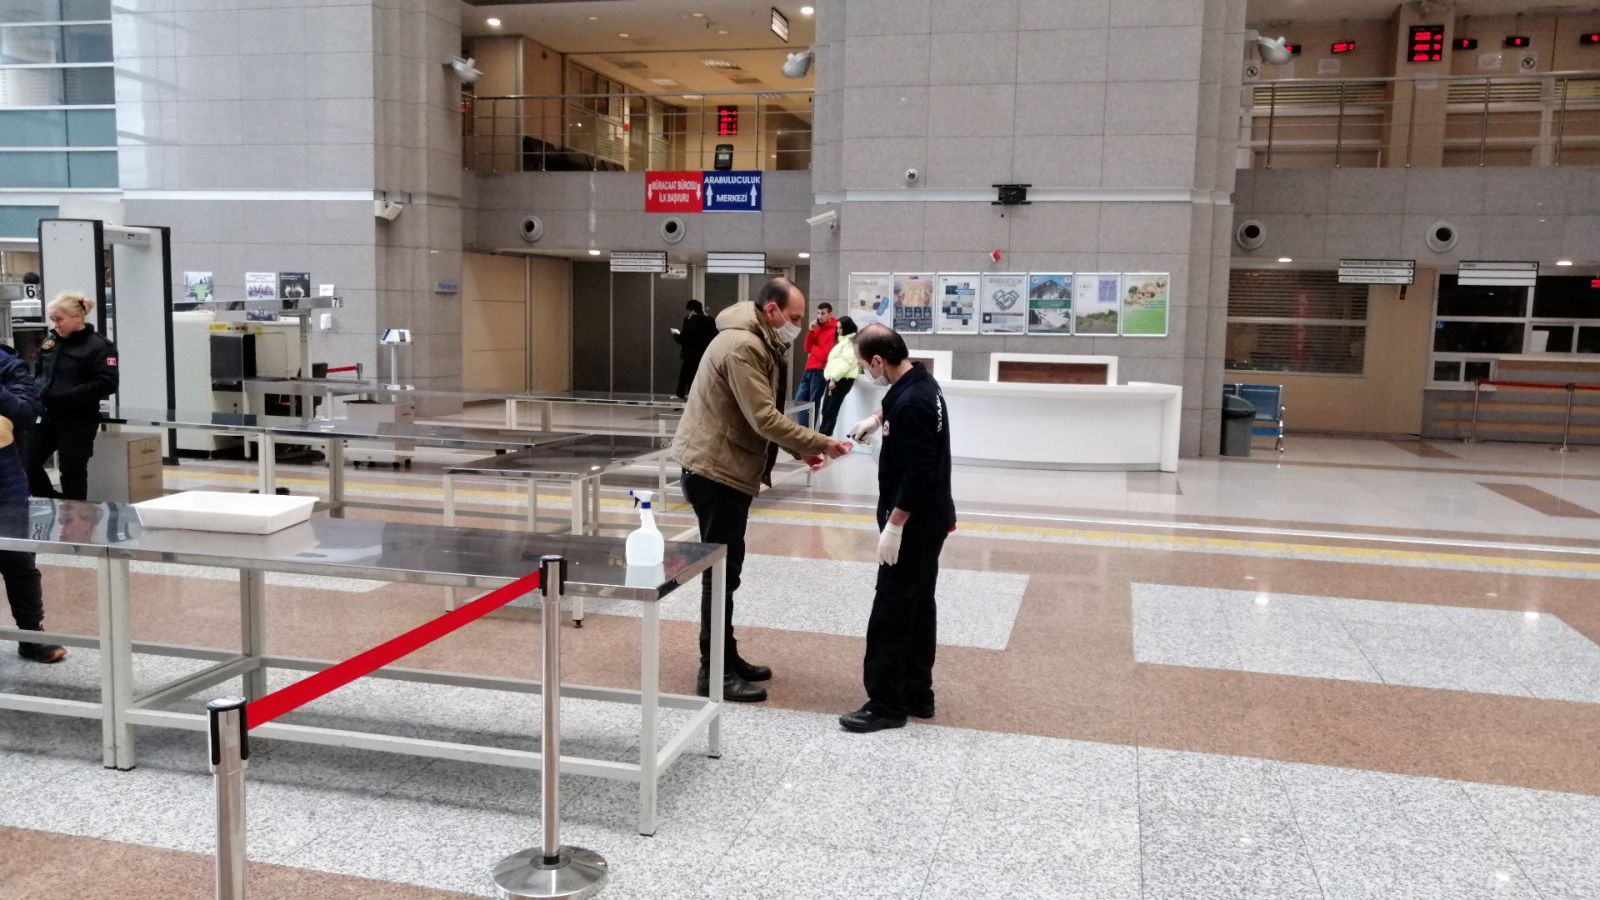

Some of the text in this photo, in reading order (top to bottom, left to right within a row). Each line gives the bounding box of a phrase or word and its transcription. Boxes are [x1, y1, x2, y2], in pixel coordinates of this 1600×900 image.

[677, 179, 697, 190] BÜROSU
[704, 176, 760, 184] ARABULUCULUK
[659, 191, 689, 204] İLK BAŞVURU
[716, 193, 748, 202] MERKEZİ
[26, 285, 35, 298] 6
[332, 297, 338, 308] 7
